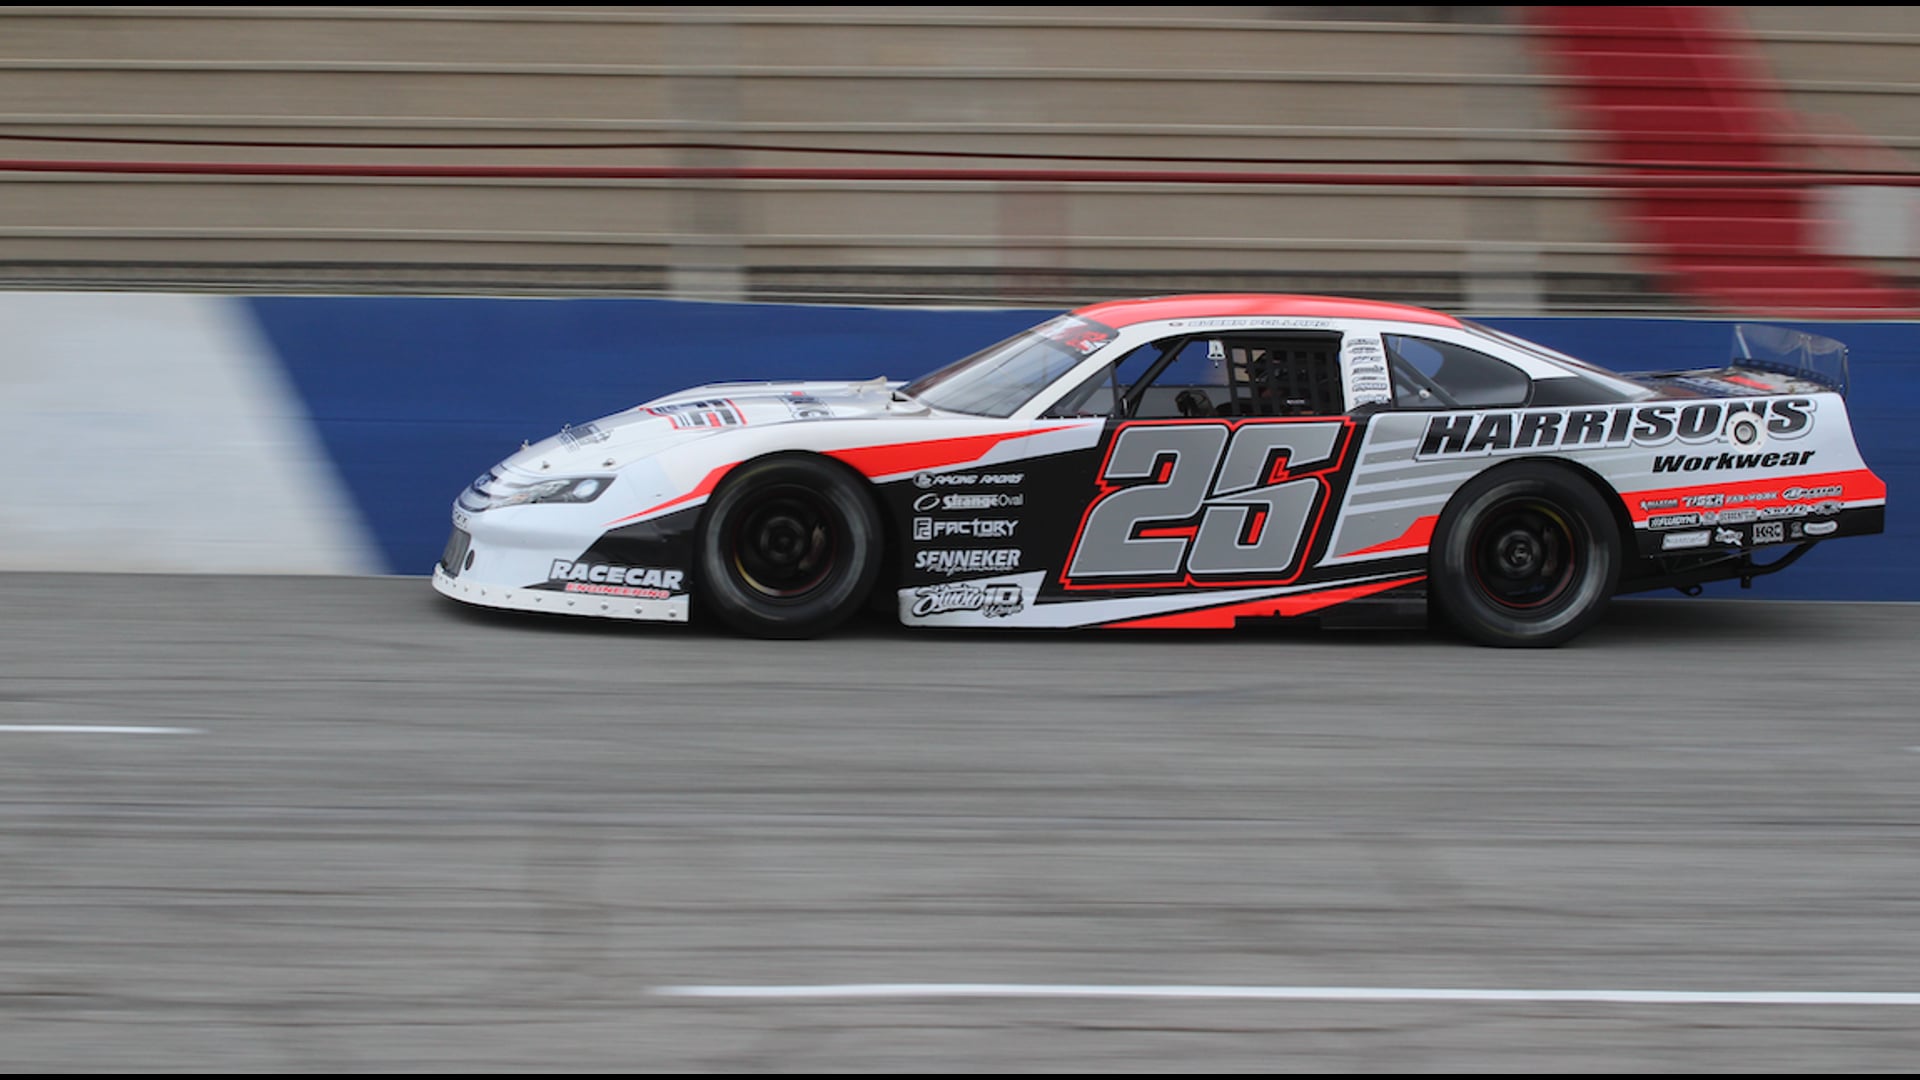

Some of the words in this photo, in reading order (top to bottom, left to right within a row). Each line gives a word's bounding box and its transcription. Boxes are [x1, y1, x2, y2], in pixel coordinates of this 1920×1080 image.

[1416, 397, 1816, 458] HARRISONS
[1652, 450, 1815, 473] Workwear
[933, 518, 1018, 537] FACTORY
[915, 549, 1022, 568] SENNEKER
[549, 558, 684, 590] RACECAR
